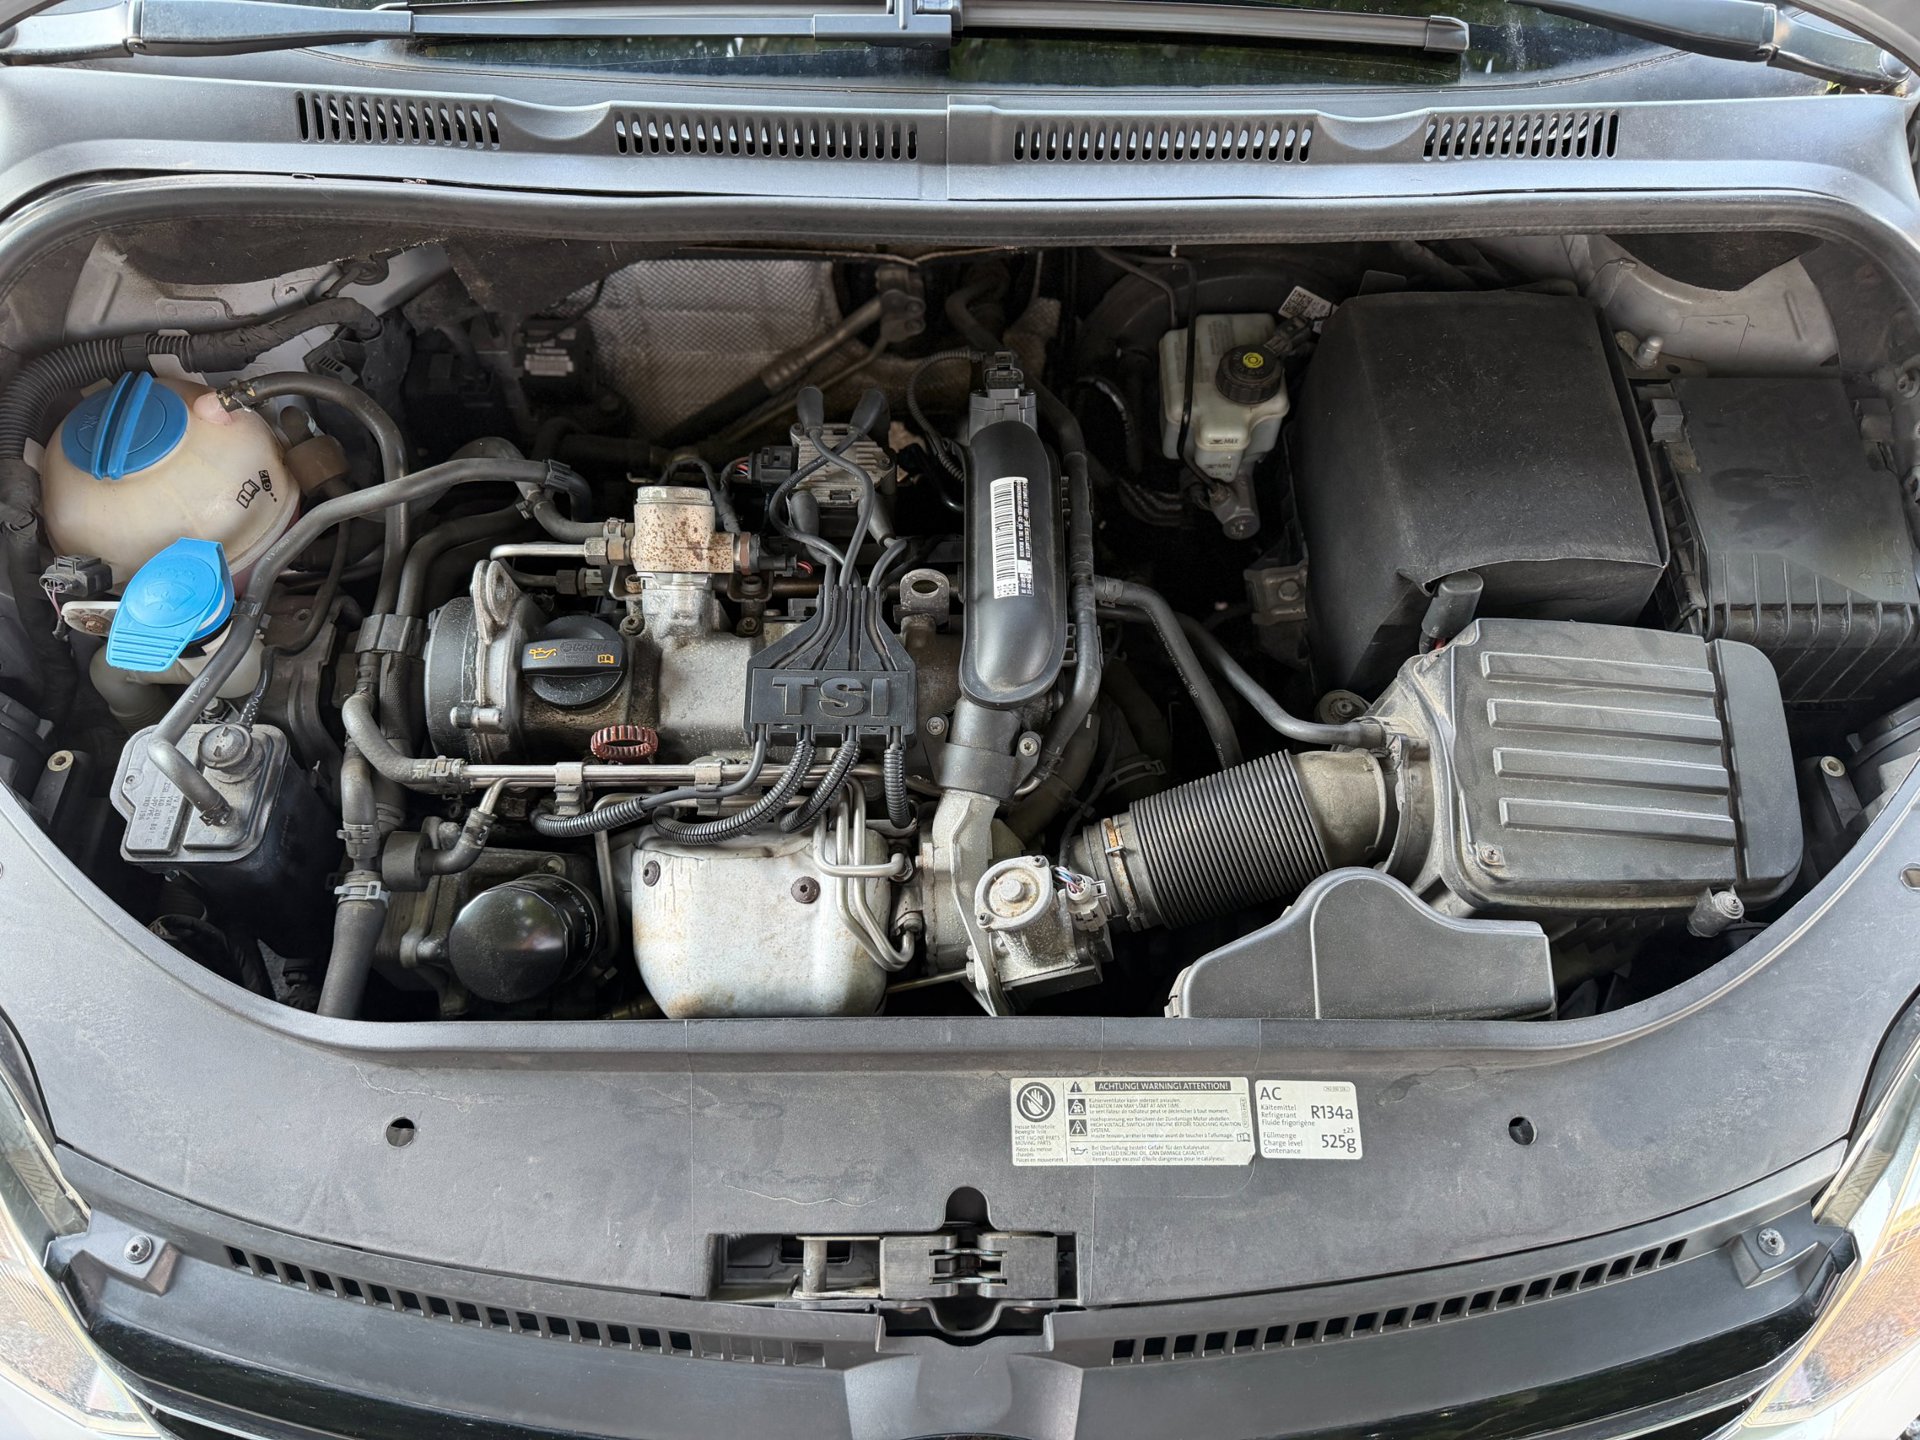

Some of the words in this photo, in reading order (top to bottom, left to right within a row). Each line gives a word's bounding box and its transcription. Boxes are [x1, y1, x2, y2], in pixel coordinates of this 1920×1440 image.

[259, 470, 272, 491] G12
[772, 677, 890, 718] TSI
[1098, 1082, 1139, 1090] ACHTUNG!
[1140, 1082, 1181, 1090] WARNING!
[1183, 1082, 1228, 1090] ATTENTION!
[1260, 1086, 1282, 1100] AC
[1261, 1112, 1296, 1120] Refrigerant
[1311, 1105, 1354, 1119] R134a
[1282, 1120, 1315, 1128] frigorigène
[1321, 1134, 1356, 1153] 525g
